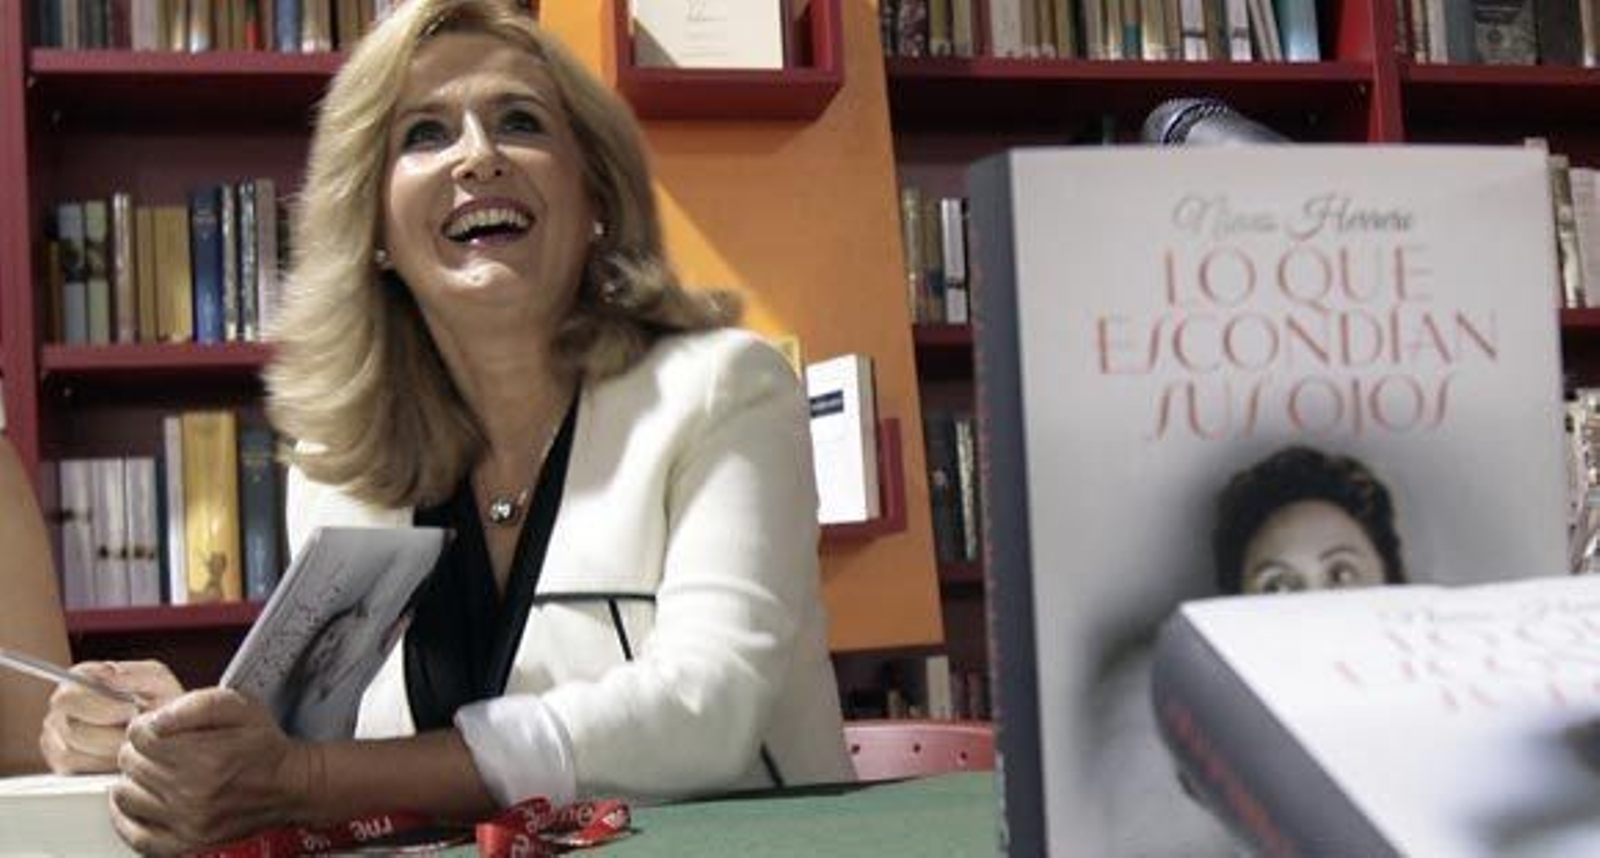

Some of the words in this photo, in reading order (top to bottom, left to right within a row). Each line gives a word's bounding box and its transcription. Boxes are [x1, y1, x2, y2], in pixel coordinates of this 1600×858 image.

[1163, 244, 1258, 307] LO
[1276, 243, 1434, 311] QUE
[1146, 374, 1273, 442] SUS
[1285, 370, 1464, 440] OJOS
